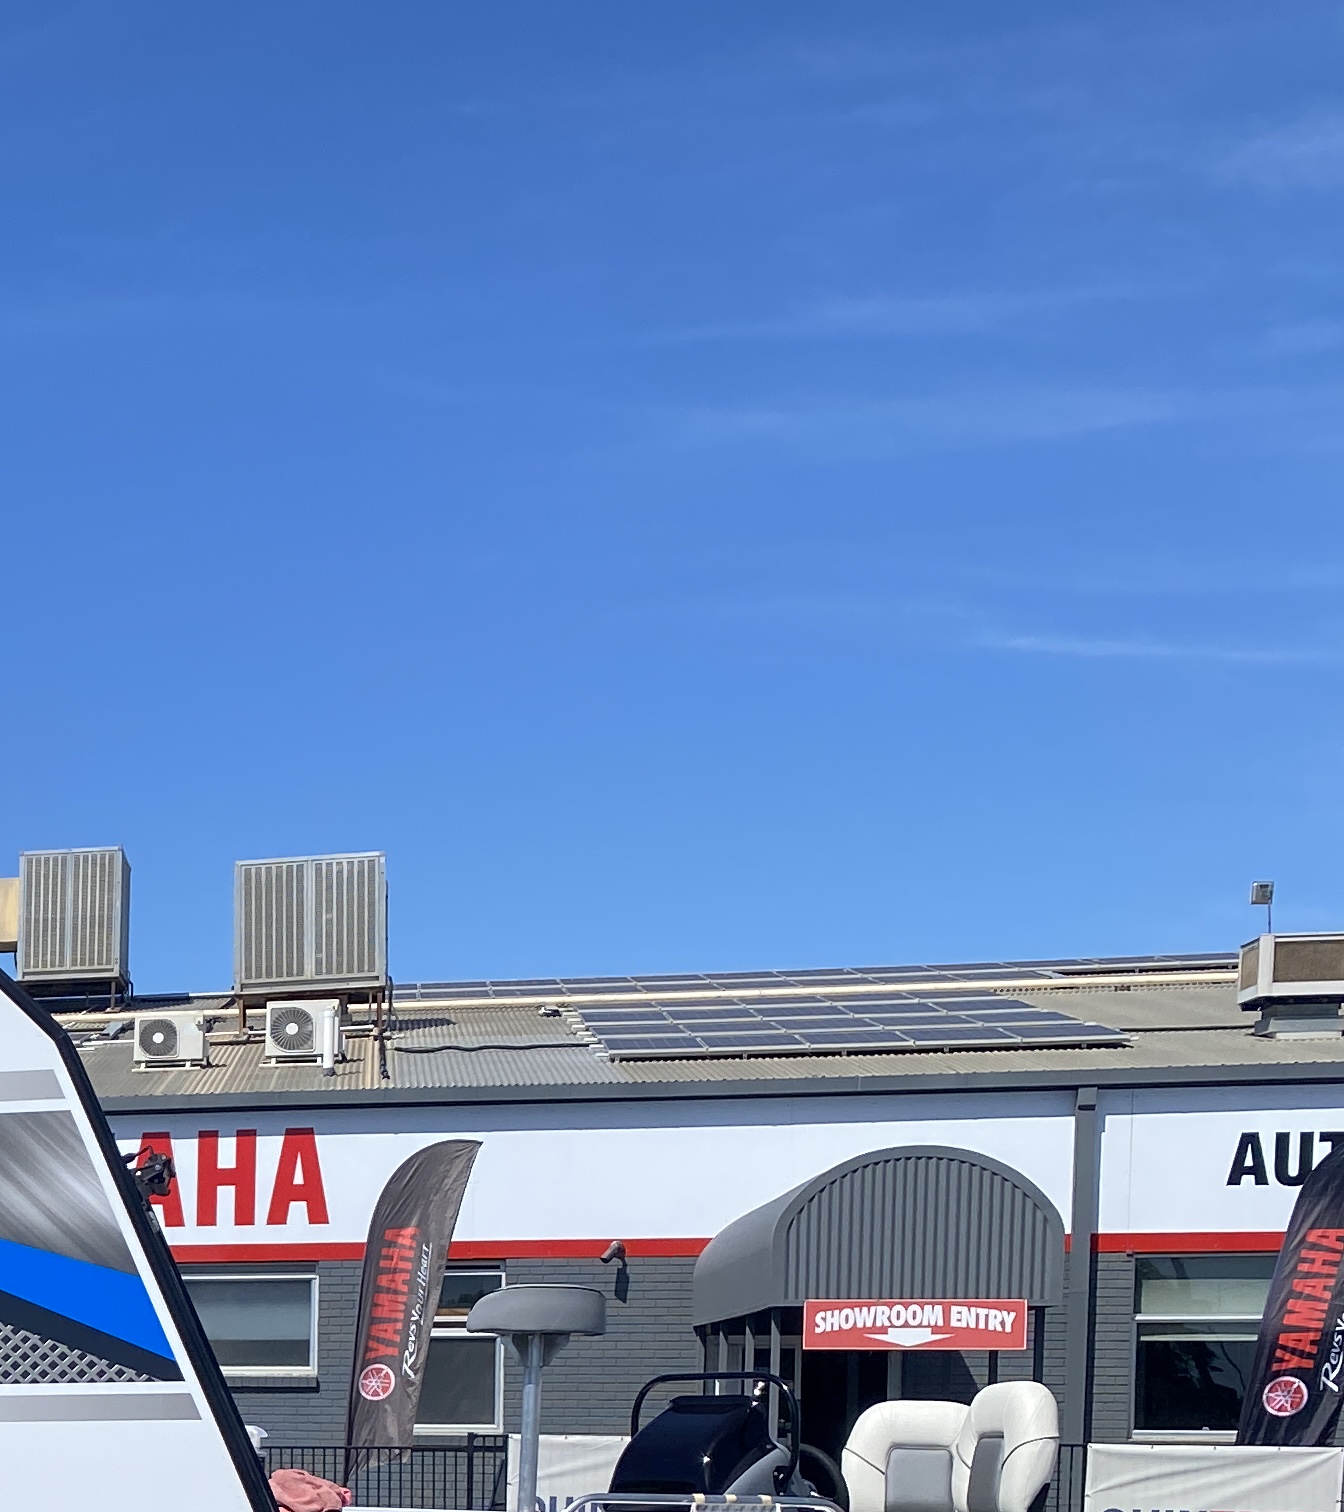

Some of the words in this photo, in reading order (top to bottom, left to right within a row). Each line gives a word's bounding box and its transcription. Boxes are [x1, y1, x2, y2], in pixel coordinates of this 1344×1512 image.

[365, 1226, 420, 1360] YAMAHA
[814, 1304, 944, 1333] SHOWROOM
[950, 1305, 1016, 1332] ENTRY
[1272, 1228, 1344, 1372] YAMAHA
[402, 1323, 417, 1379] Revs
